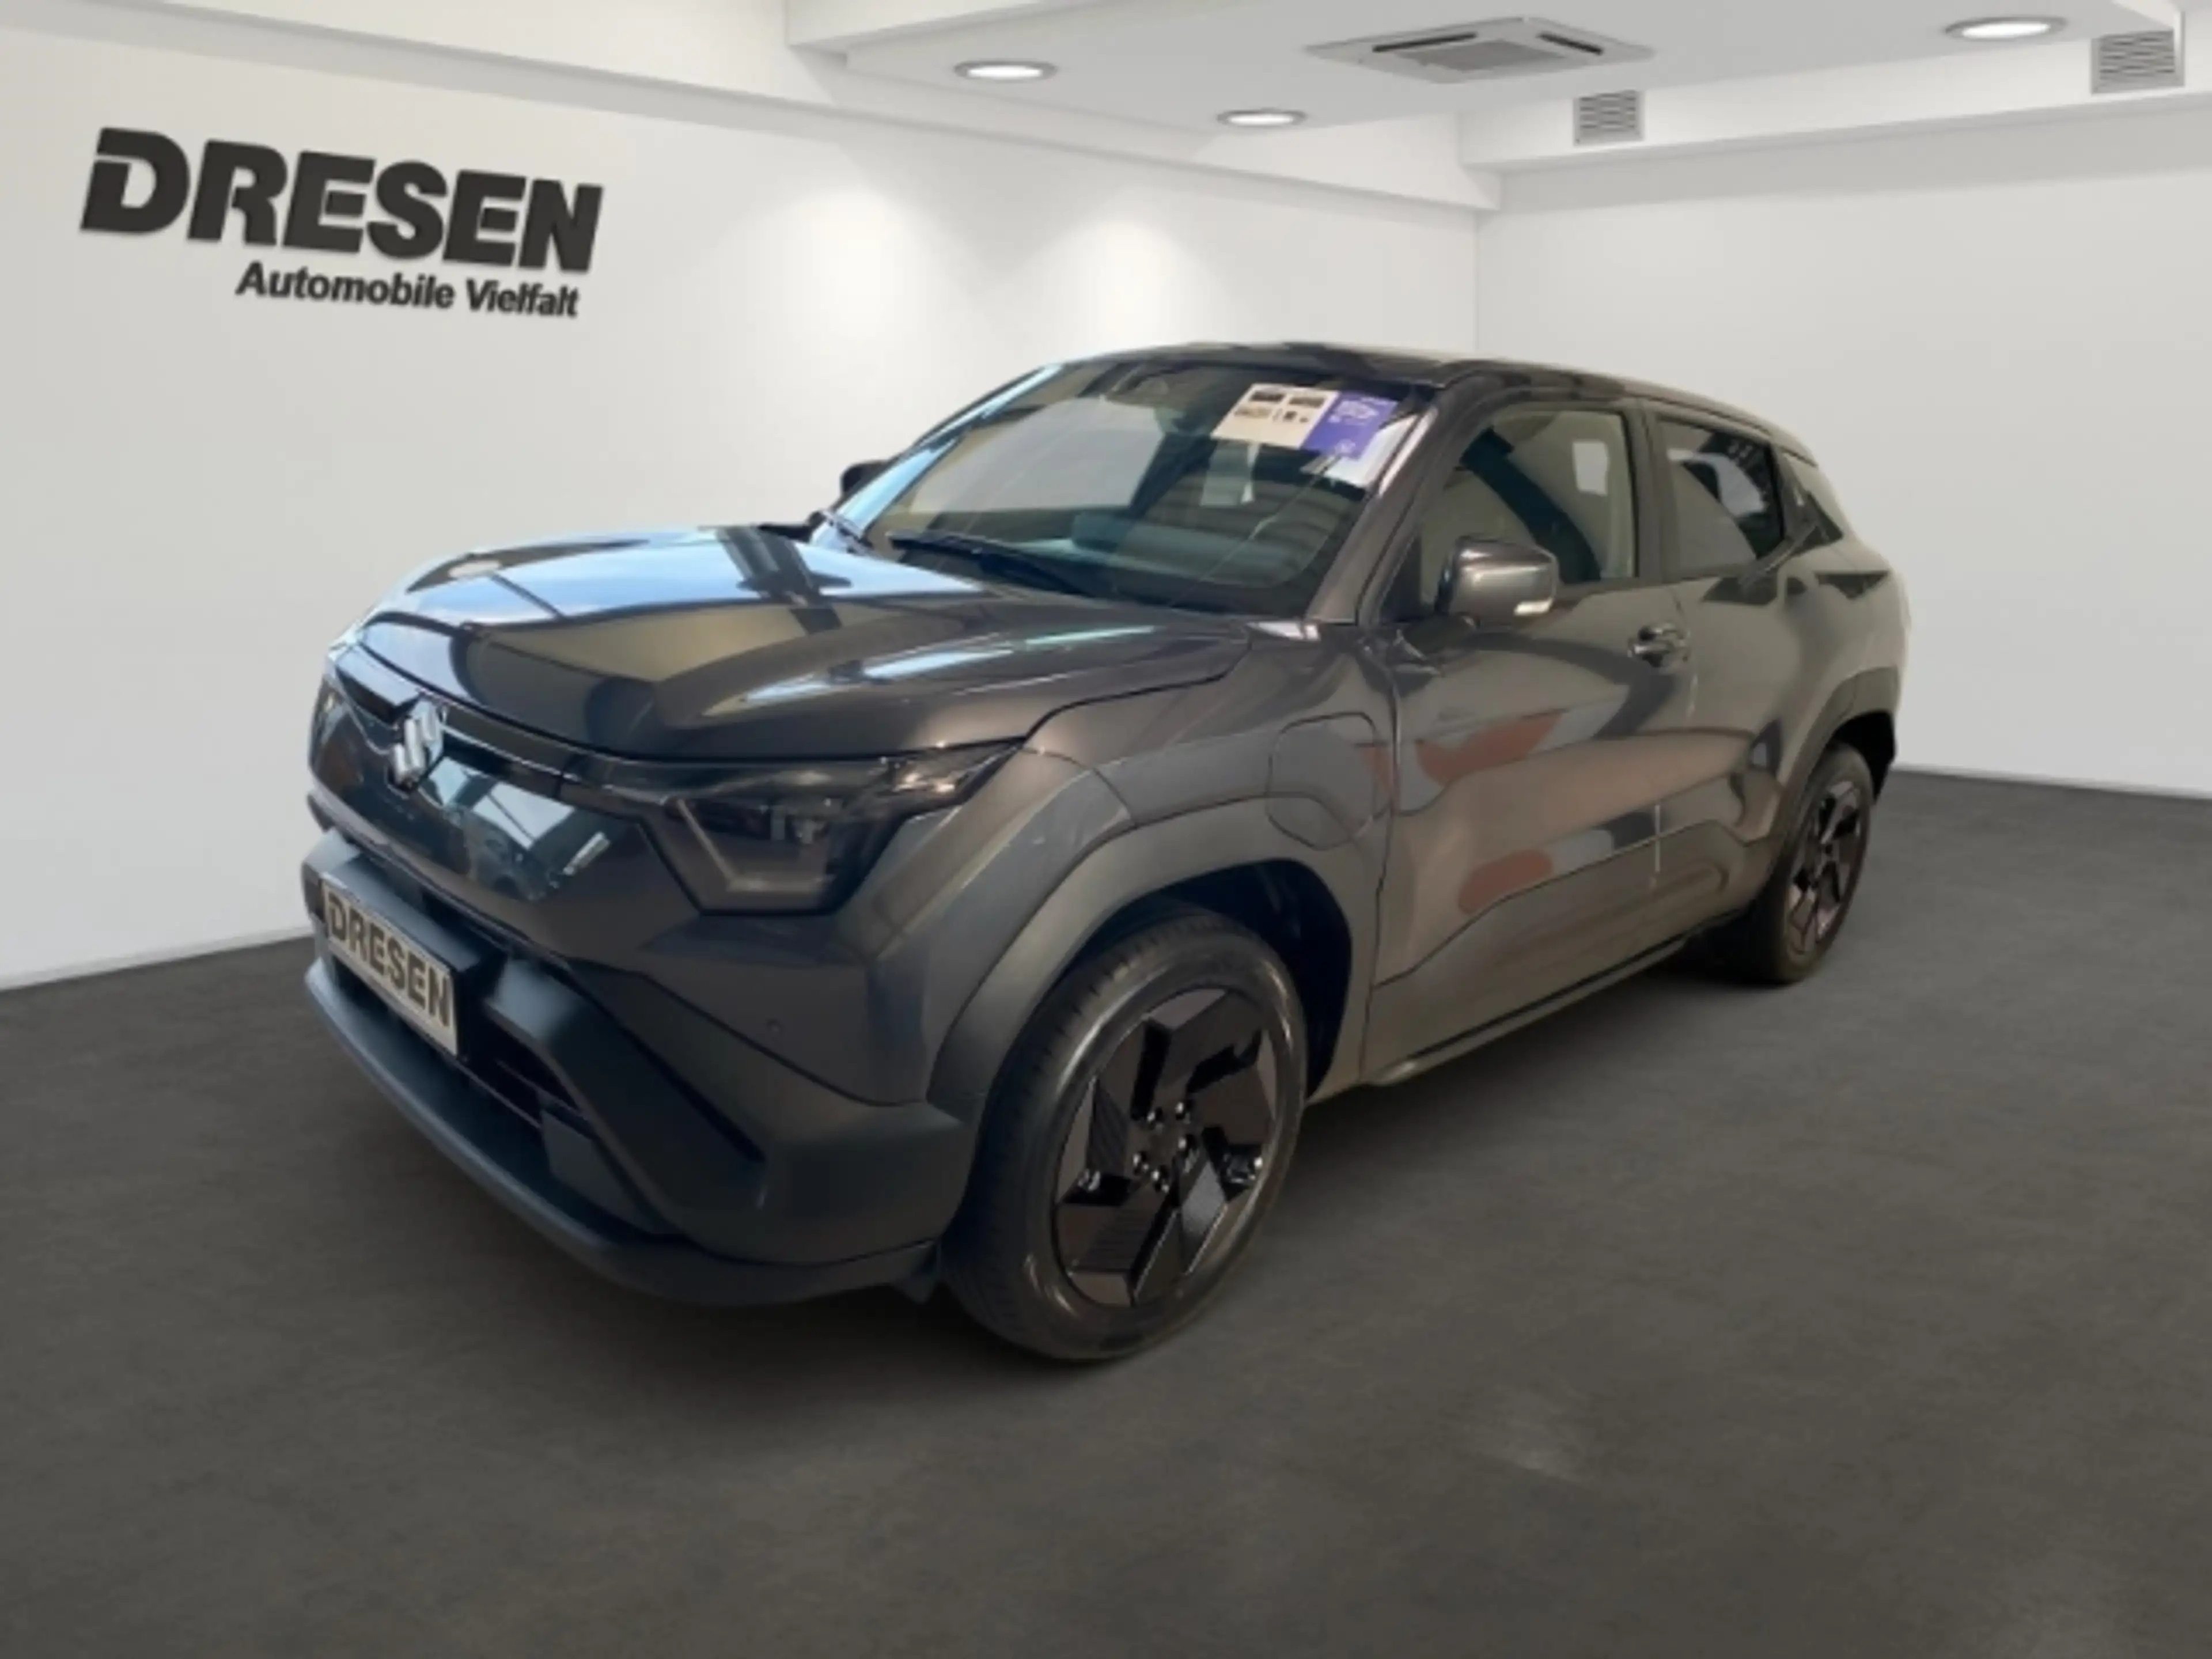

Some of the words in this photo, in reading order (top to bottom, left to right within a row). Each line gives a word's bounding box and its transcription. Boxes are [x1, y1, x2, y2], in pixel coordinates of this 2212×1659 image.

[81, 127, 604, 274] DRESEN
[236, 261, 454, 309] Automobile
[466, 278, 579, 317] Vielfalt
[329, 893, 450, 1027] DRESEN
